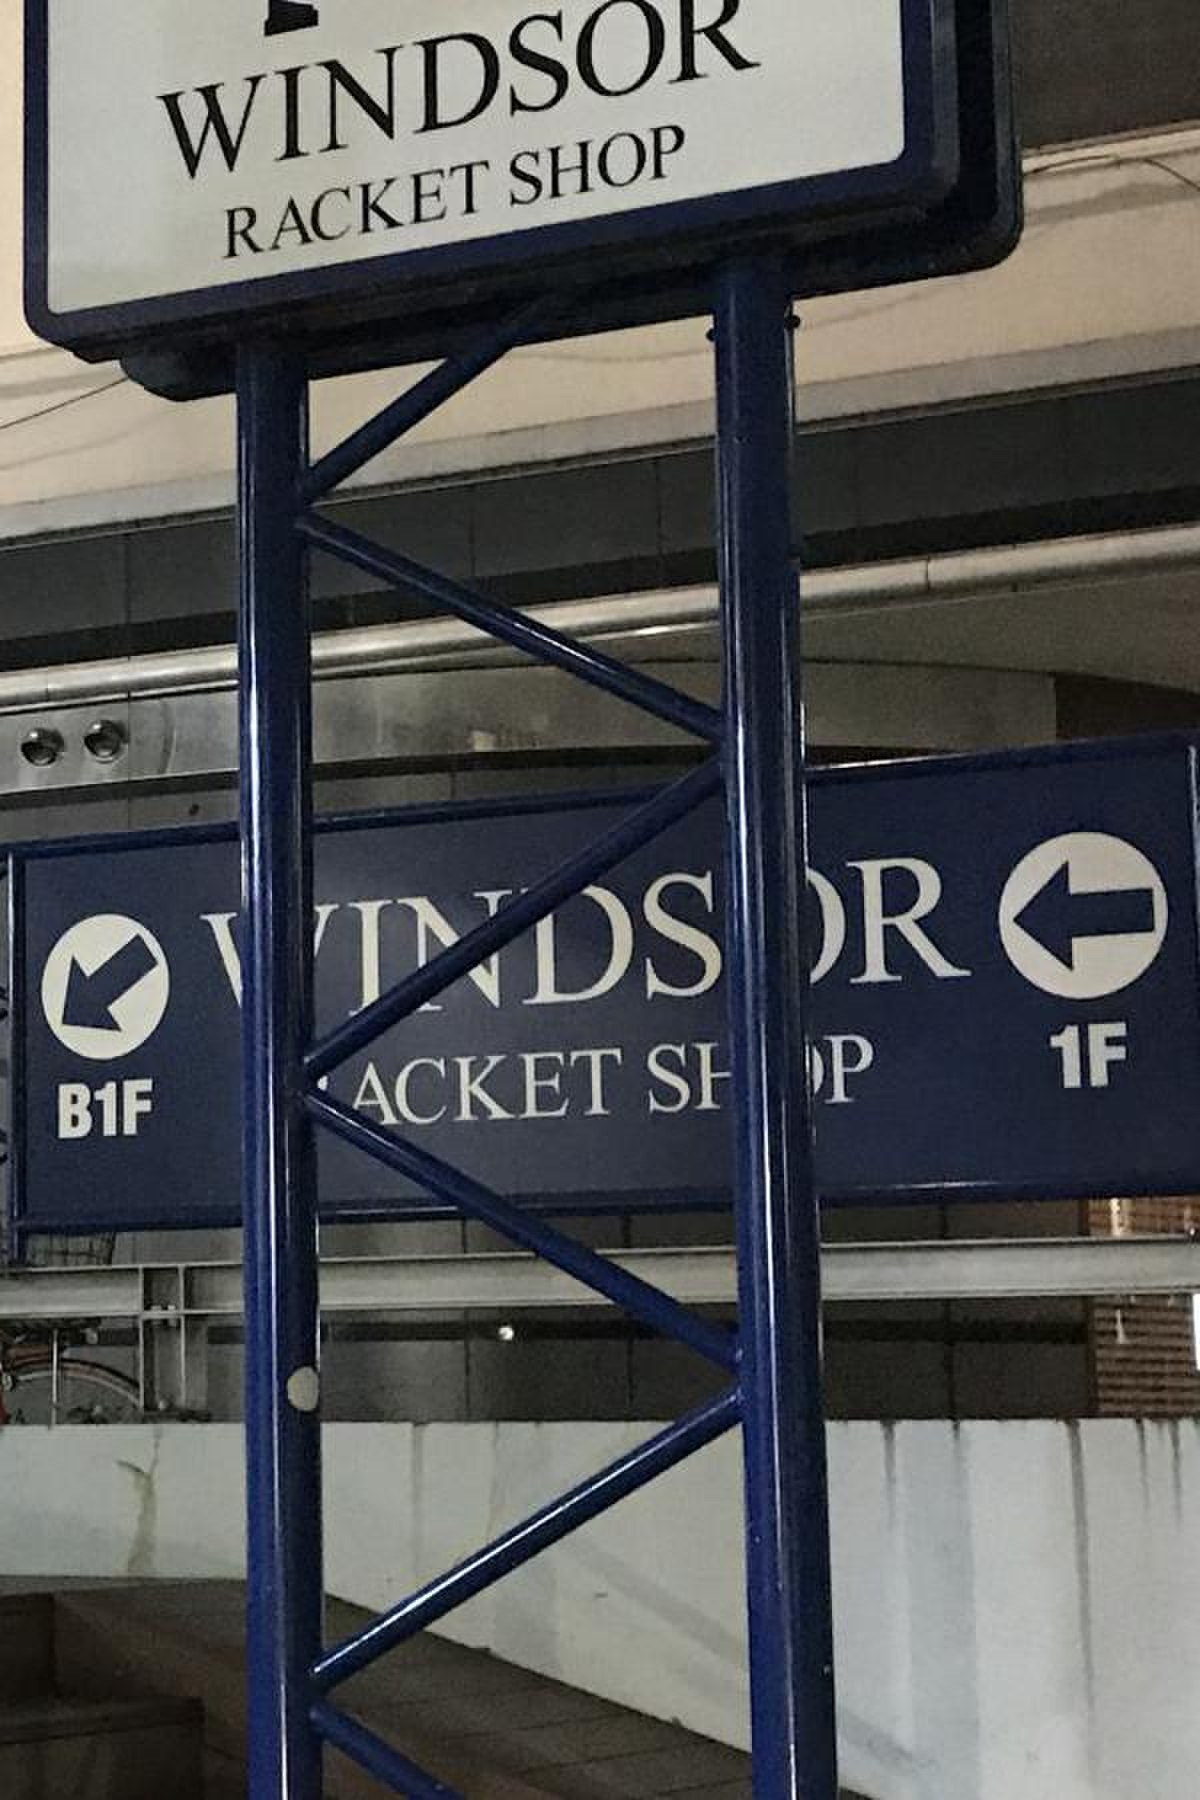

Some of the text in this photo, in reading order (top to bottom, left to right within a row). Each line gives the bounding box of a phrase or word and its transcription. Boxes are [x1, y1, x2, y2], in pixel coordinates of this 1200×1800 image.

[156, 0, 762, 180] WINDSOR
[221, 124, 686, 259] RACKET SHOP
[316, 1034, 875, 1126] ACKET SHP
[1050, 1021, 1127, 1089] 1F
[58, 1079, 153, 1139] B1F
